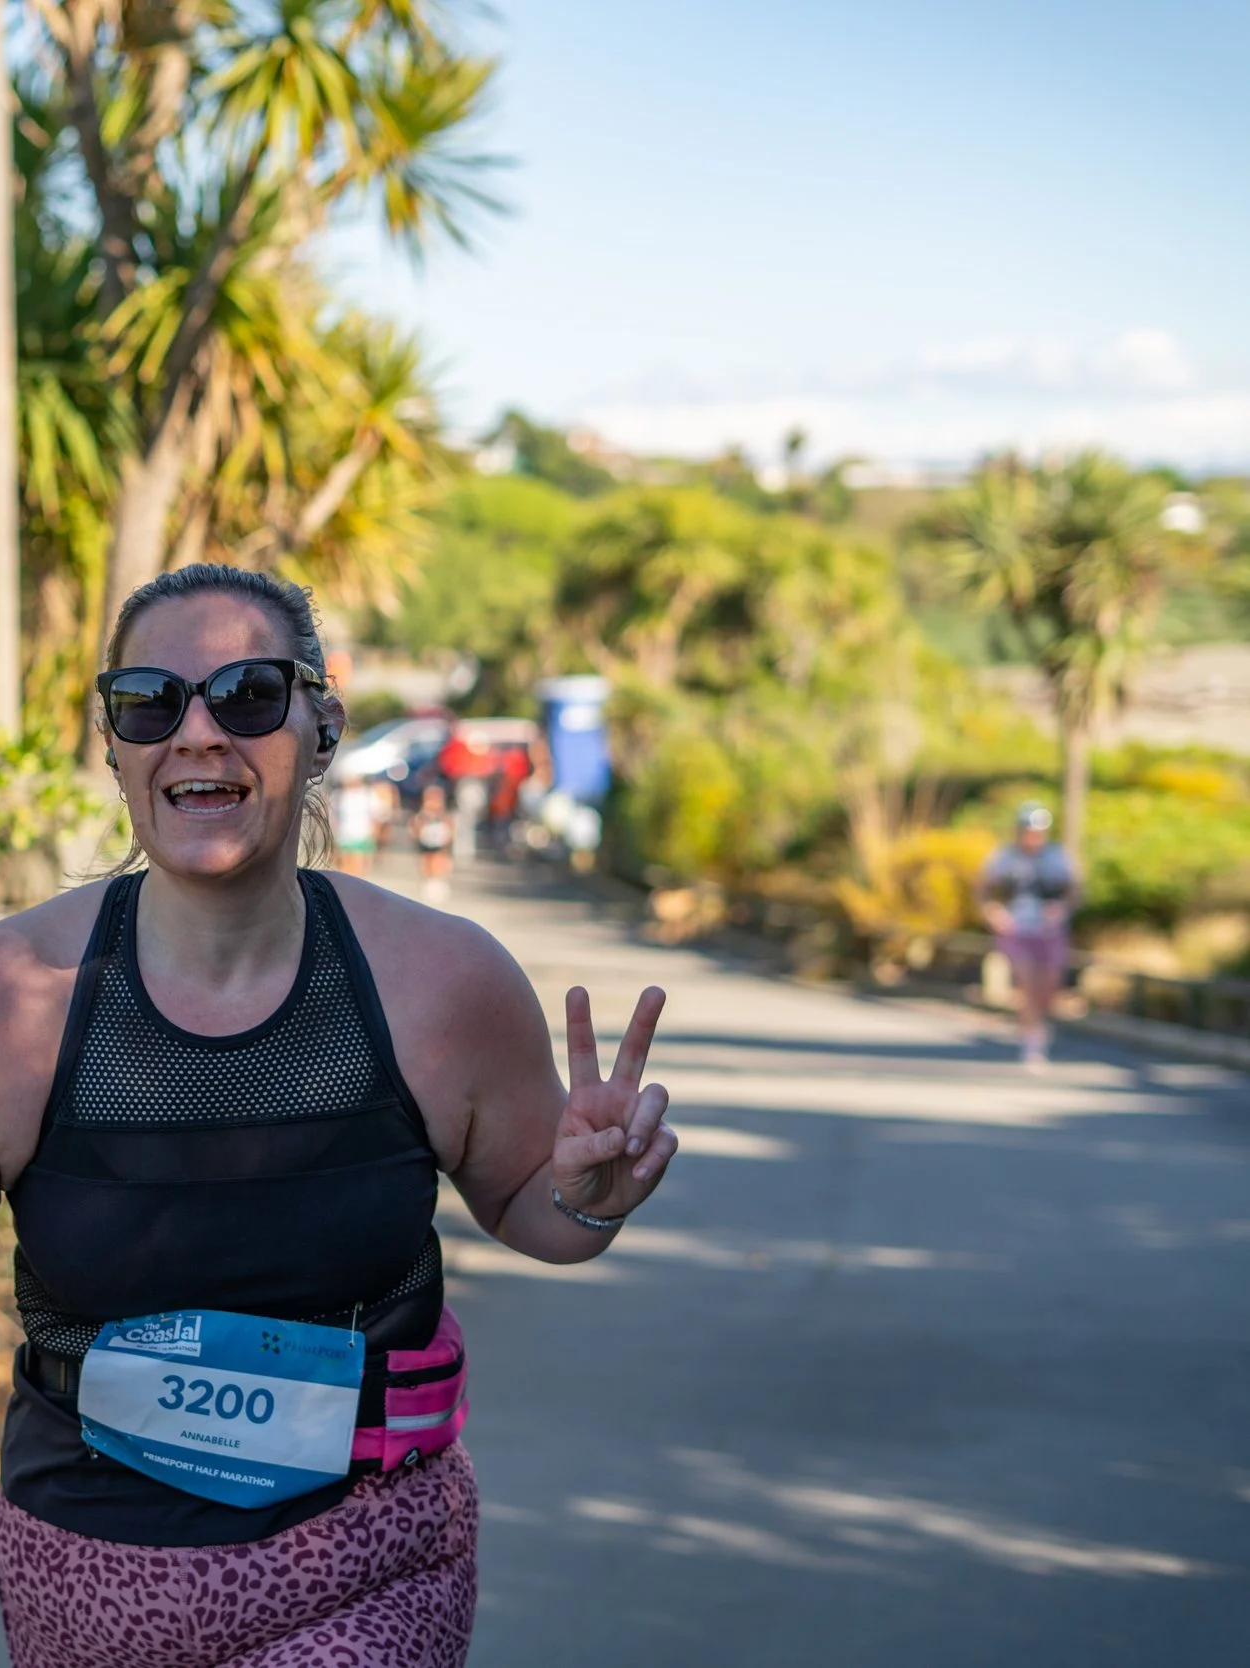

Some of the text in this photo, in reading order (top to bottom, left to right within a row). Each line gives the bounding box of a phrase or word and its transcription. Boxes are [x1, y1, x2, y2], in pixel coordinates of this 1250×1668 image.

[126, 1315, 202, 1342] Coastal
[144, 1322, 160, 1330] The
[158, 1374, 275, 1424] 3200
[180, 1430, 240, 1448] ANNABELLE
[143, 1451, 275, 1488] PRIMEPORT HALF MARATHON
